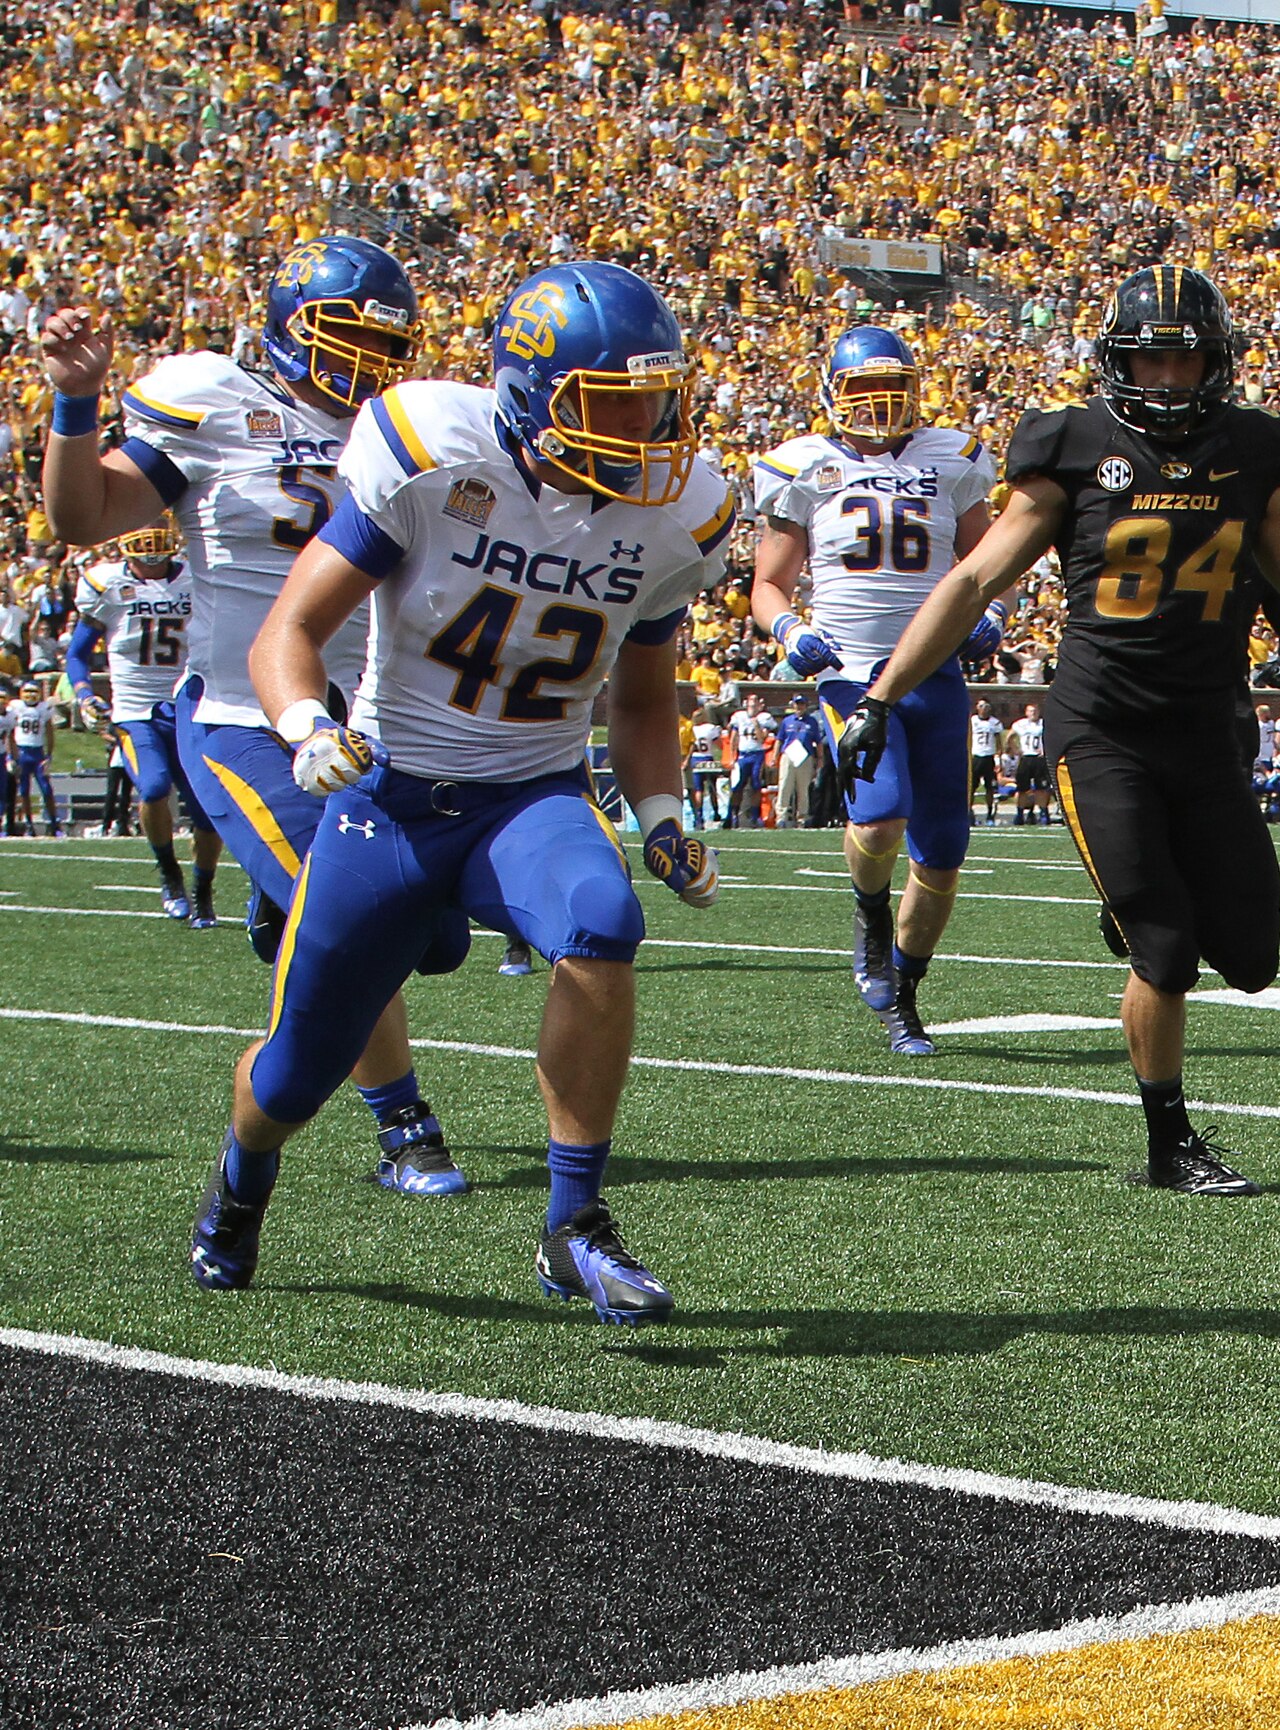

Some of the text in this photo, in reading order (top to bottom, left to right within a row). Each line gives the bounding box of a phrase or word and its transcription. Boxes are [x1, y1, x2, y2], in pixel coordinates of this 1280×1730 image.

[1153, 327, 1182, 335] TIGERS
[644, 355, 672, 368] STATE
[272, 439, 345, 465] JAC
[1101, 459, 1130, 489] SEC
[1131, 493, 1221, 512] MIZZOU
[840, 495, 931, 574] 36
[451, 534, 644, 604] JACKS
[1094, 514, 1247, 622] 84
[127, 601, 192, 615] JACKS
[139, 617, 185, 666] 15
[423, 582, 609, 722] 42
